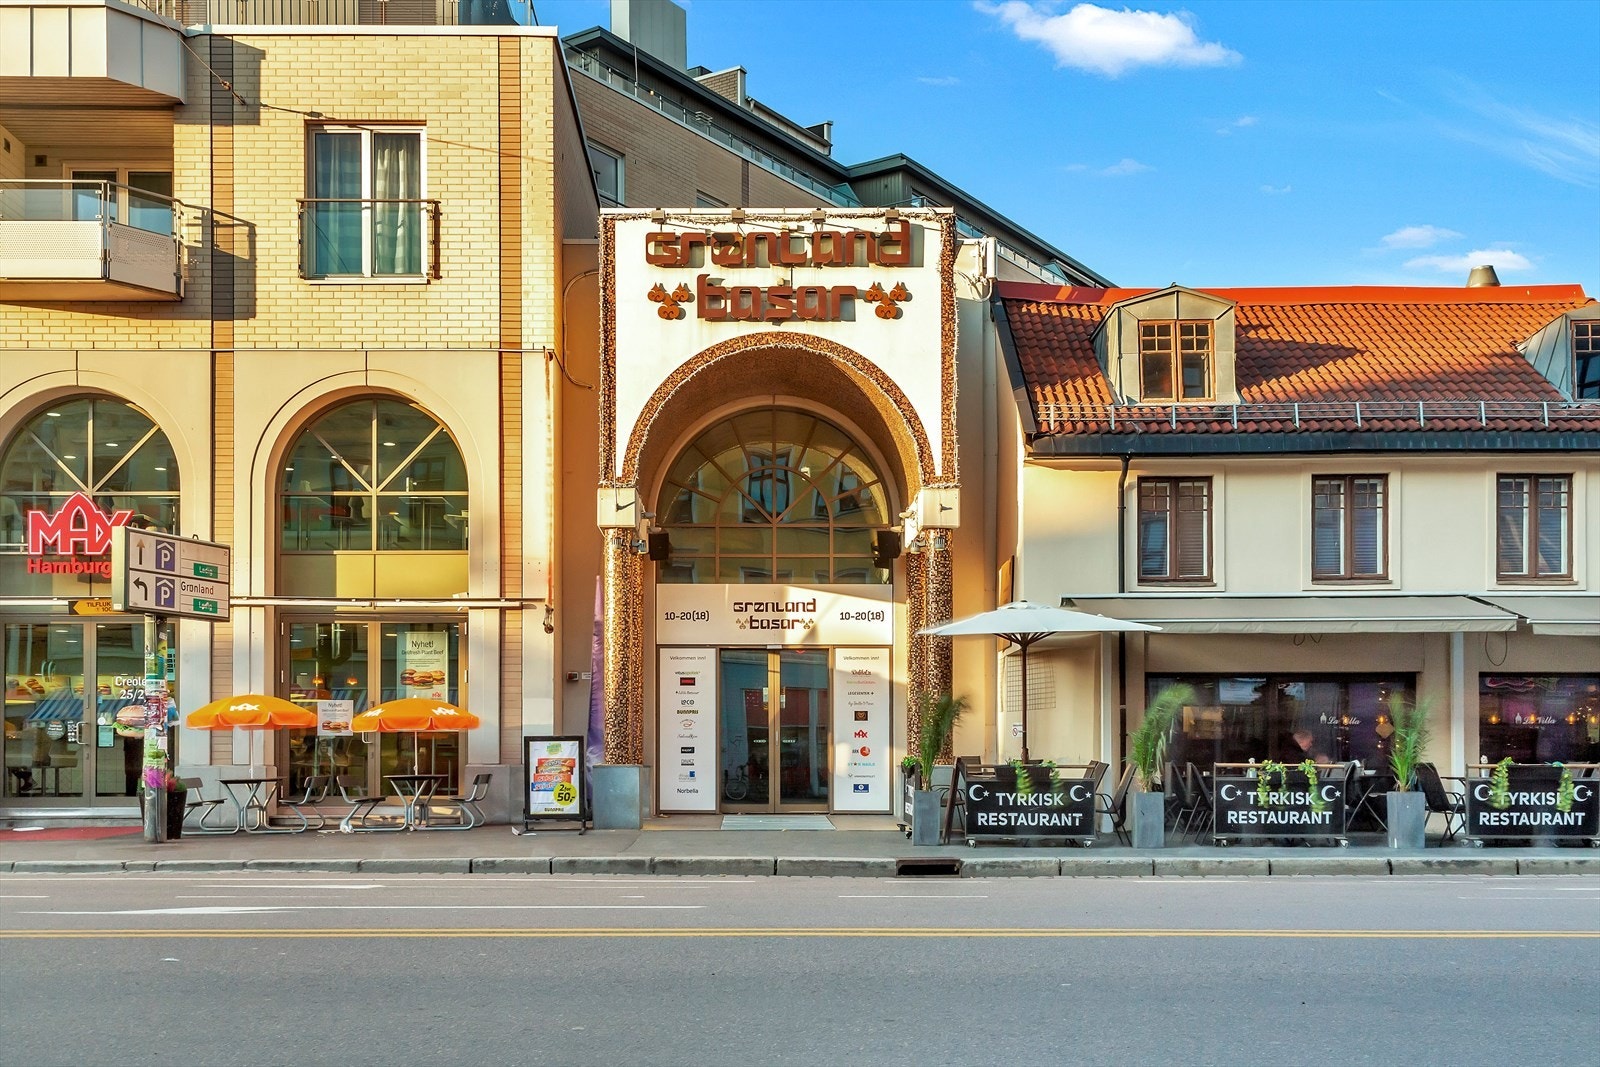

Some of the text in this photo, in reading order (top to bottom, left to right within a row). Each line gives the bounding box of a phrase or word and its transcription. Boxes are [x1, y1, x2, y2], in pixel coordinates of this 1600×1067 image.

[697, 273, 858, 320] basar
[27, 491, 134, 556] MAX
[664, 611, 710, 621] 10-20(18)
[839, 611, 885, 621] 10-20(18)
[749, 616, 800, 630] basar
[411, 640, 434, 649] Nyhet!
[115, 677, 146, 687] Creole
[854, 729, 868, 738] MAX
[557, 793, 575, 803] 50,-
[995, 793, 1065, 806] TYRKISK
[977, 812, 1083, 827] RESTAURANT
[1227, 810, 1333, 825] RESTAURANT
[1479, 812, 1586, 826] RESTAURANT
